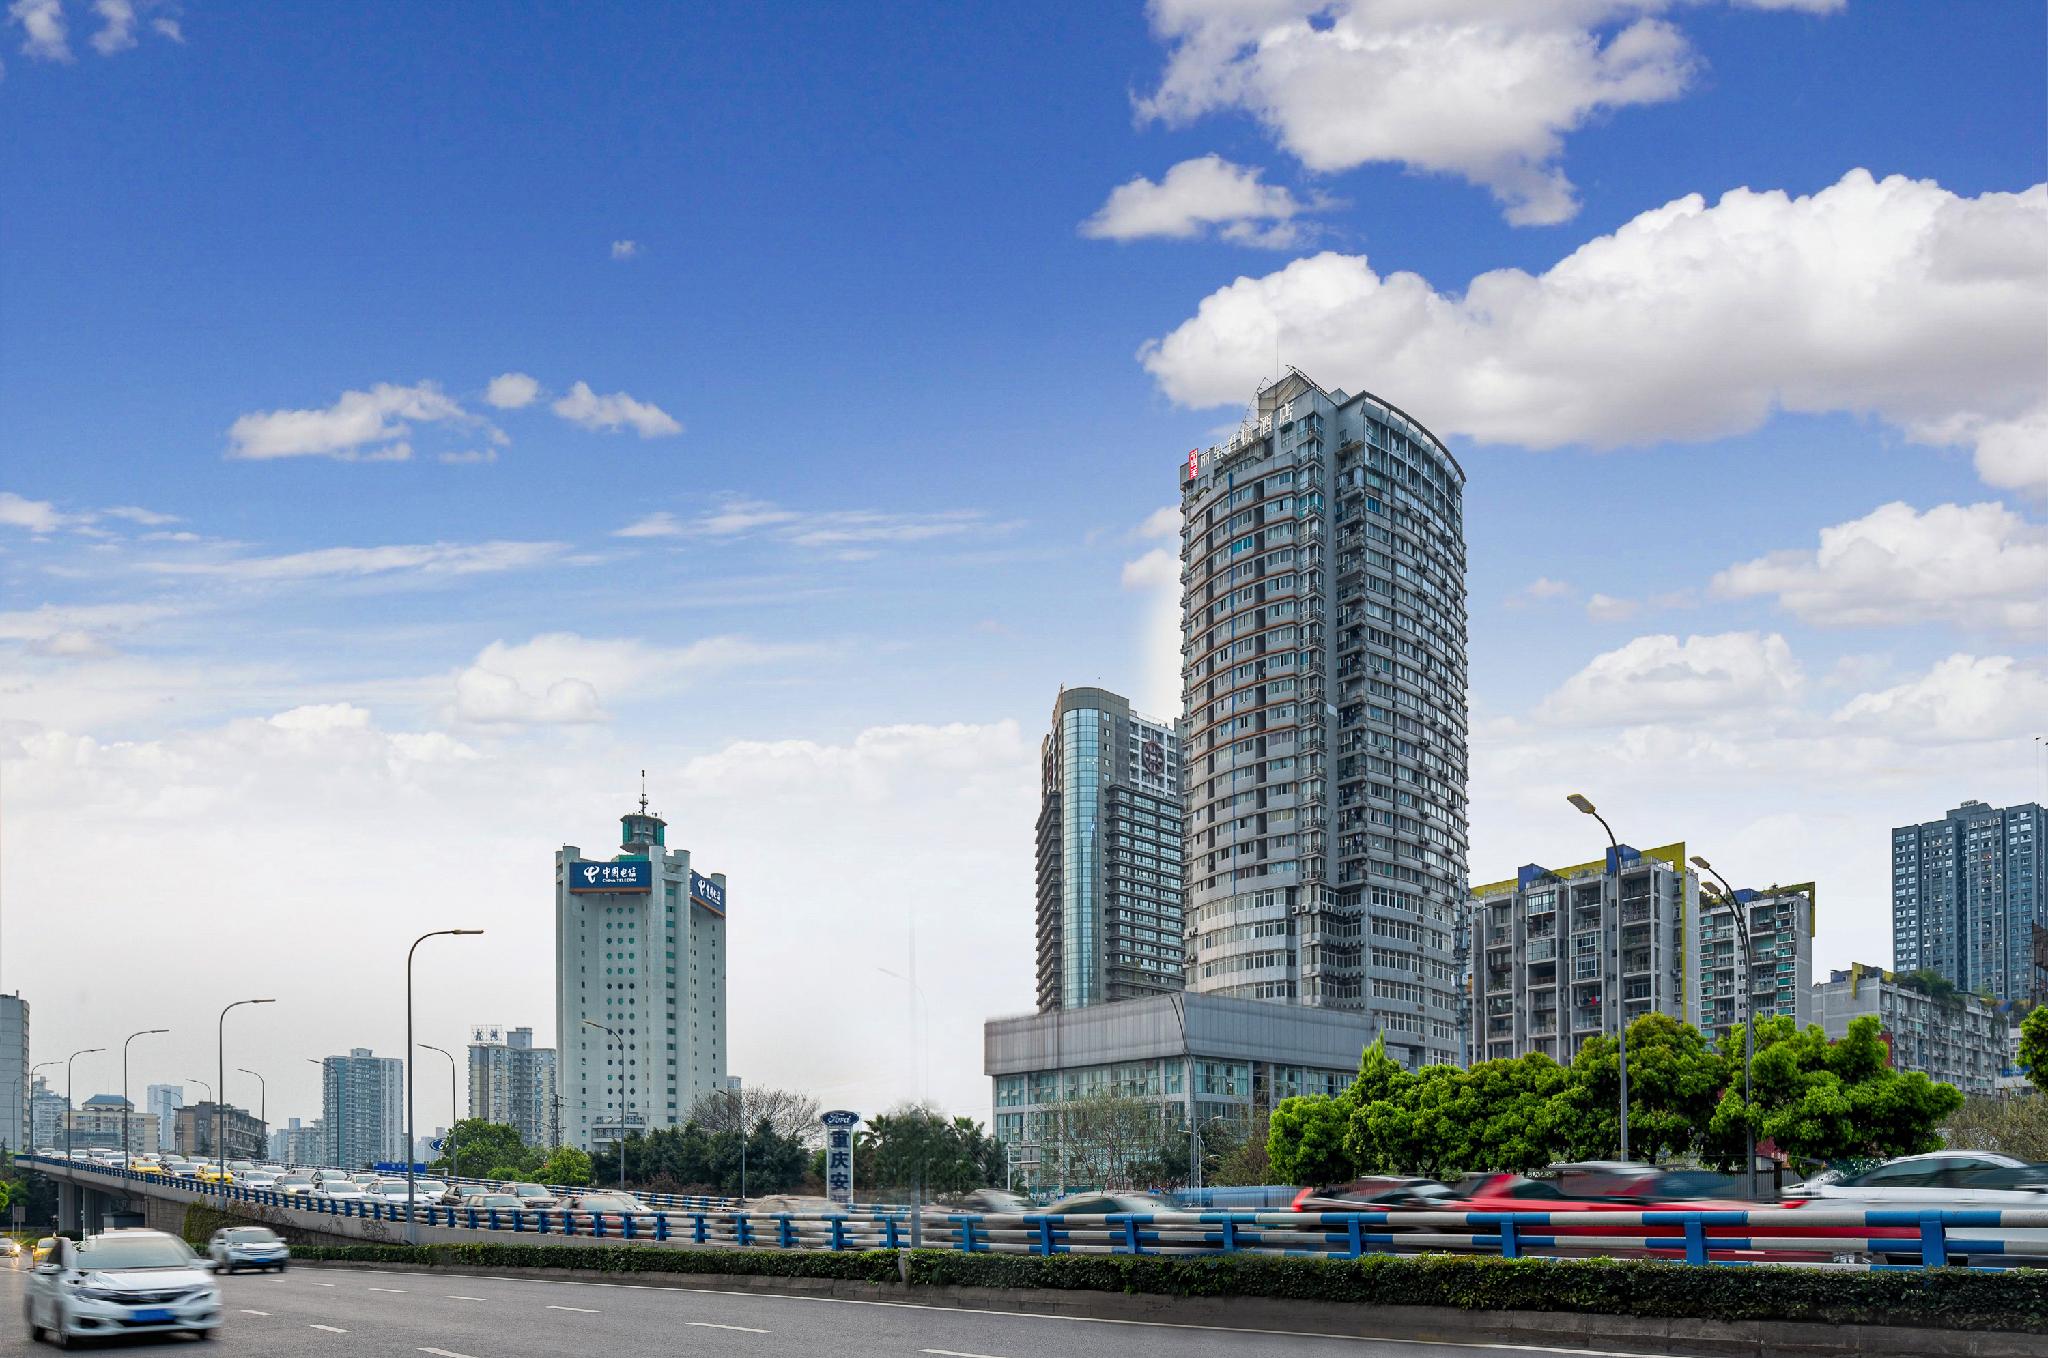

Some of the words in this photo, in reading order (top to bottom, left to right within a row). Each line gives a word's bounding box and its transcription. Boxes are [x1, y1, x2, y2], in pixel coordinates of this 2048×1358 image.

[602, 866, 637, 879] 中国电信
[827, 1113, 852, 1124] Ford
